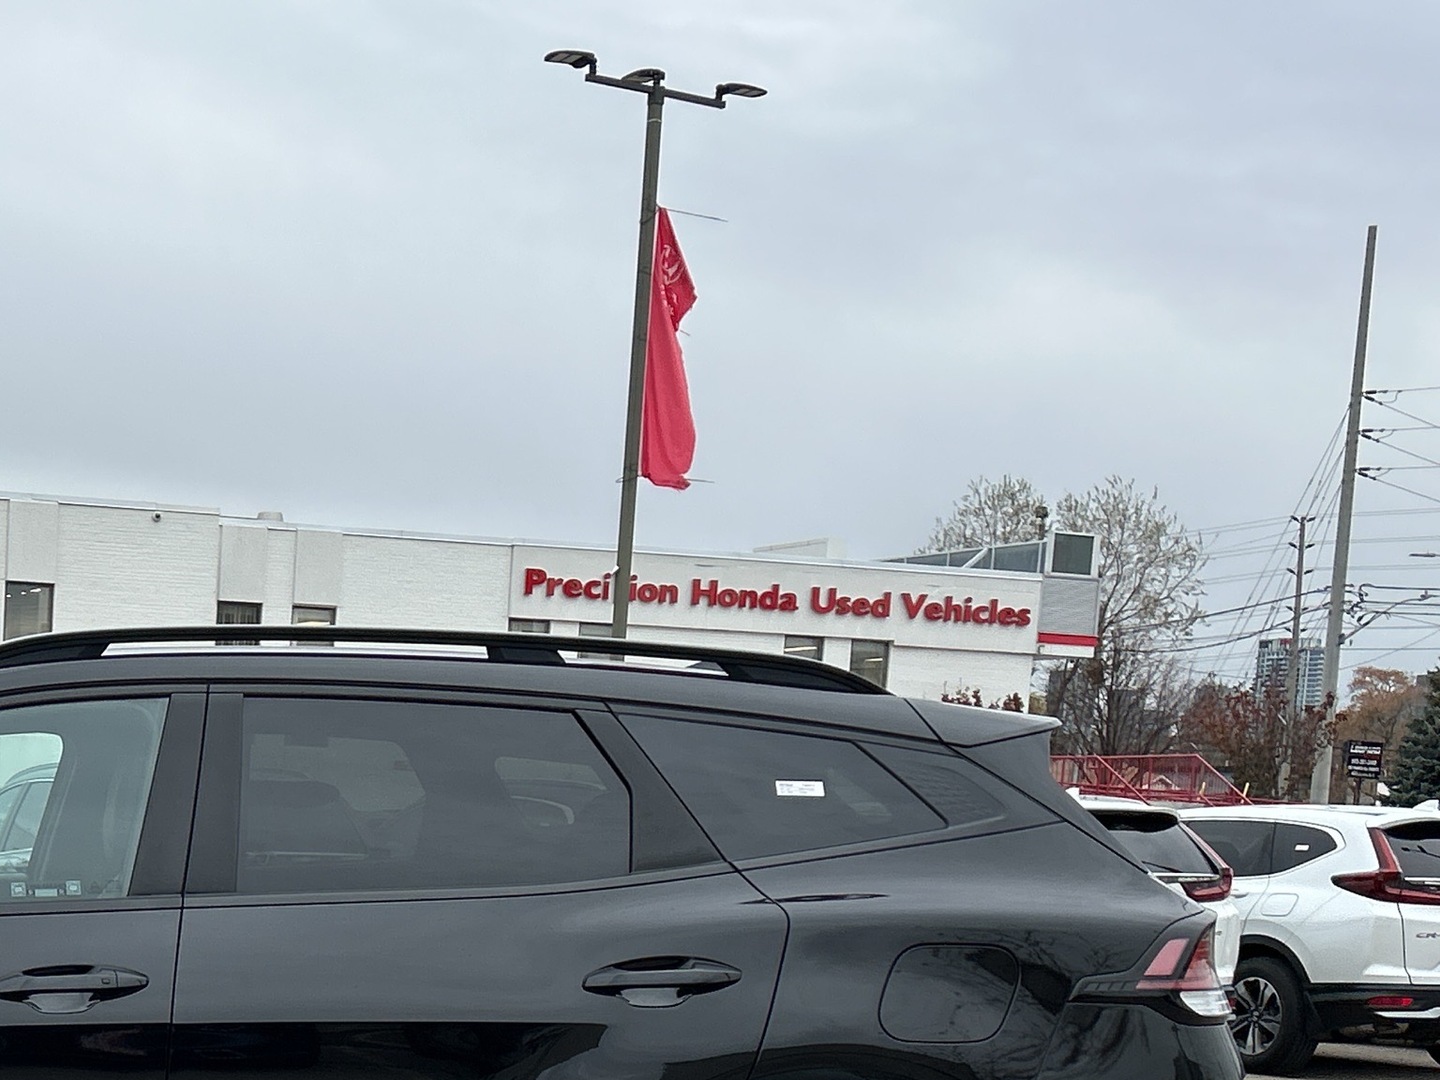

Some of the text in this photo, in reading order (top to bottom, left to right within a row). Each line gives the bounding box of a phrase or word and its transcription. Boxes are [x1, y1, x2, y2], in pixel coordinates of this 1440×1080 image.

[524, 568, 1031, 626] Preciion Honda Used Vehicles
